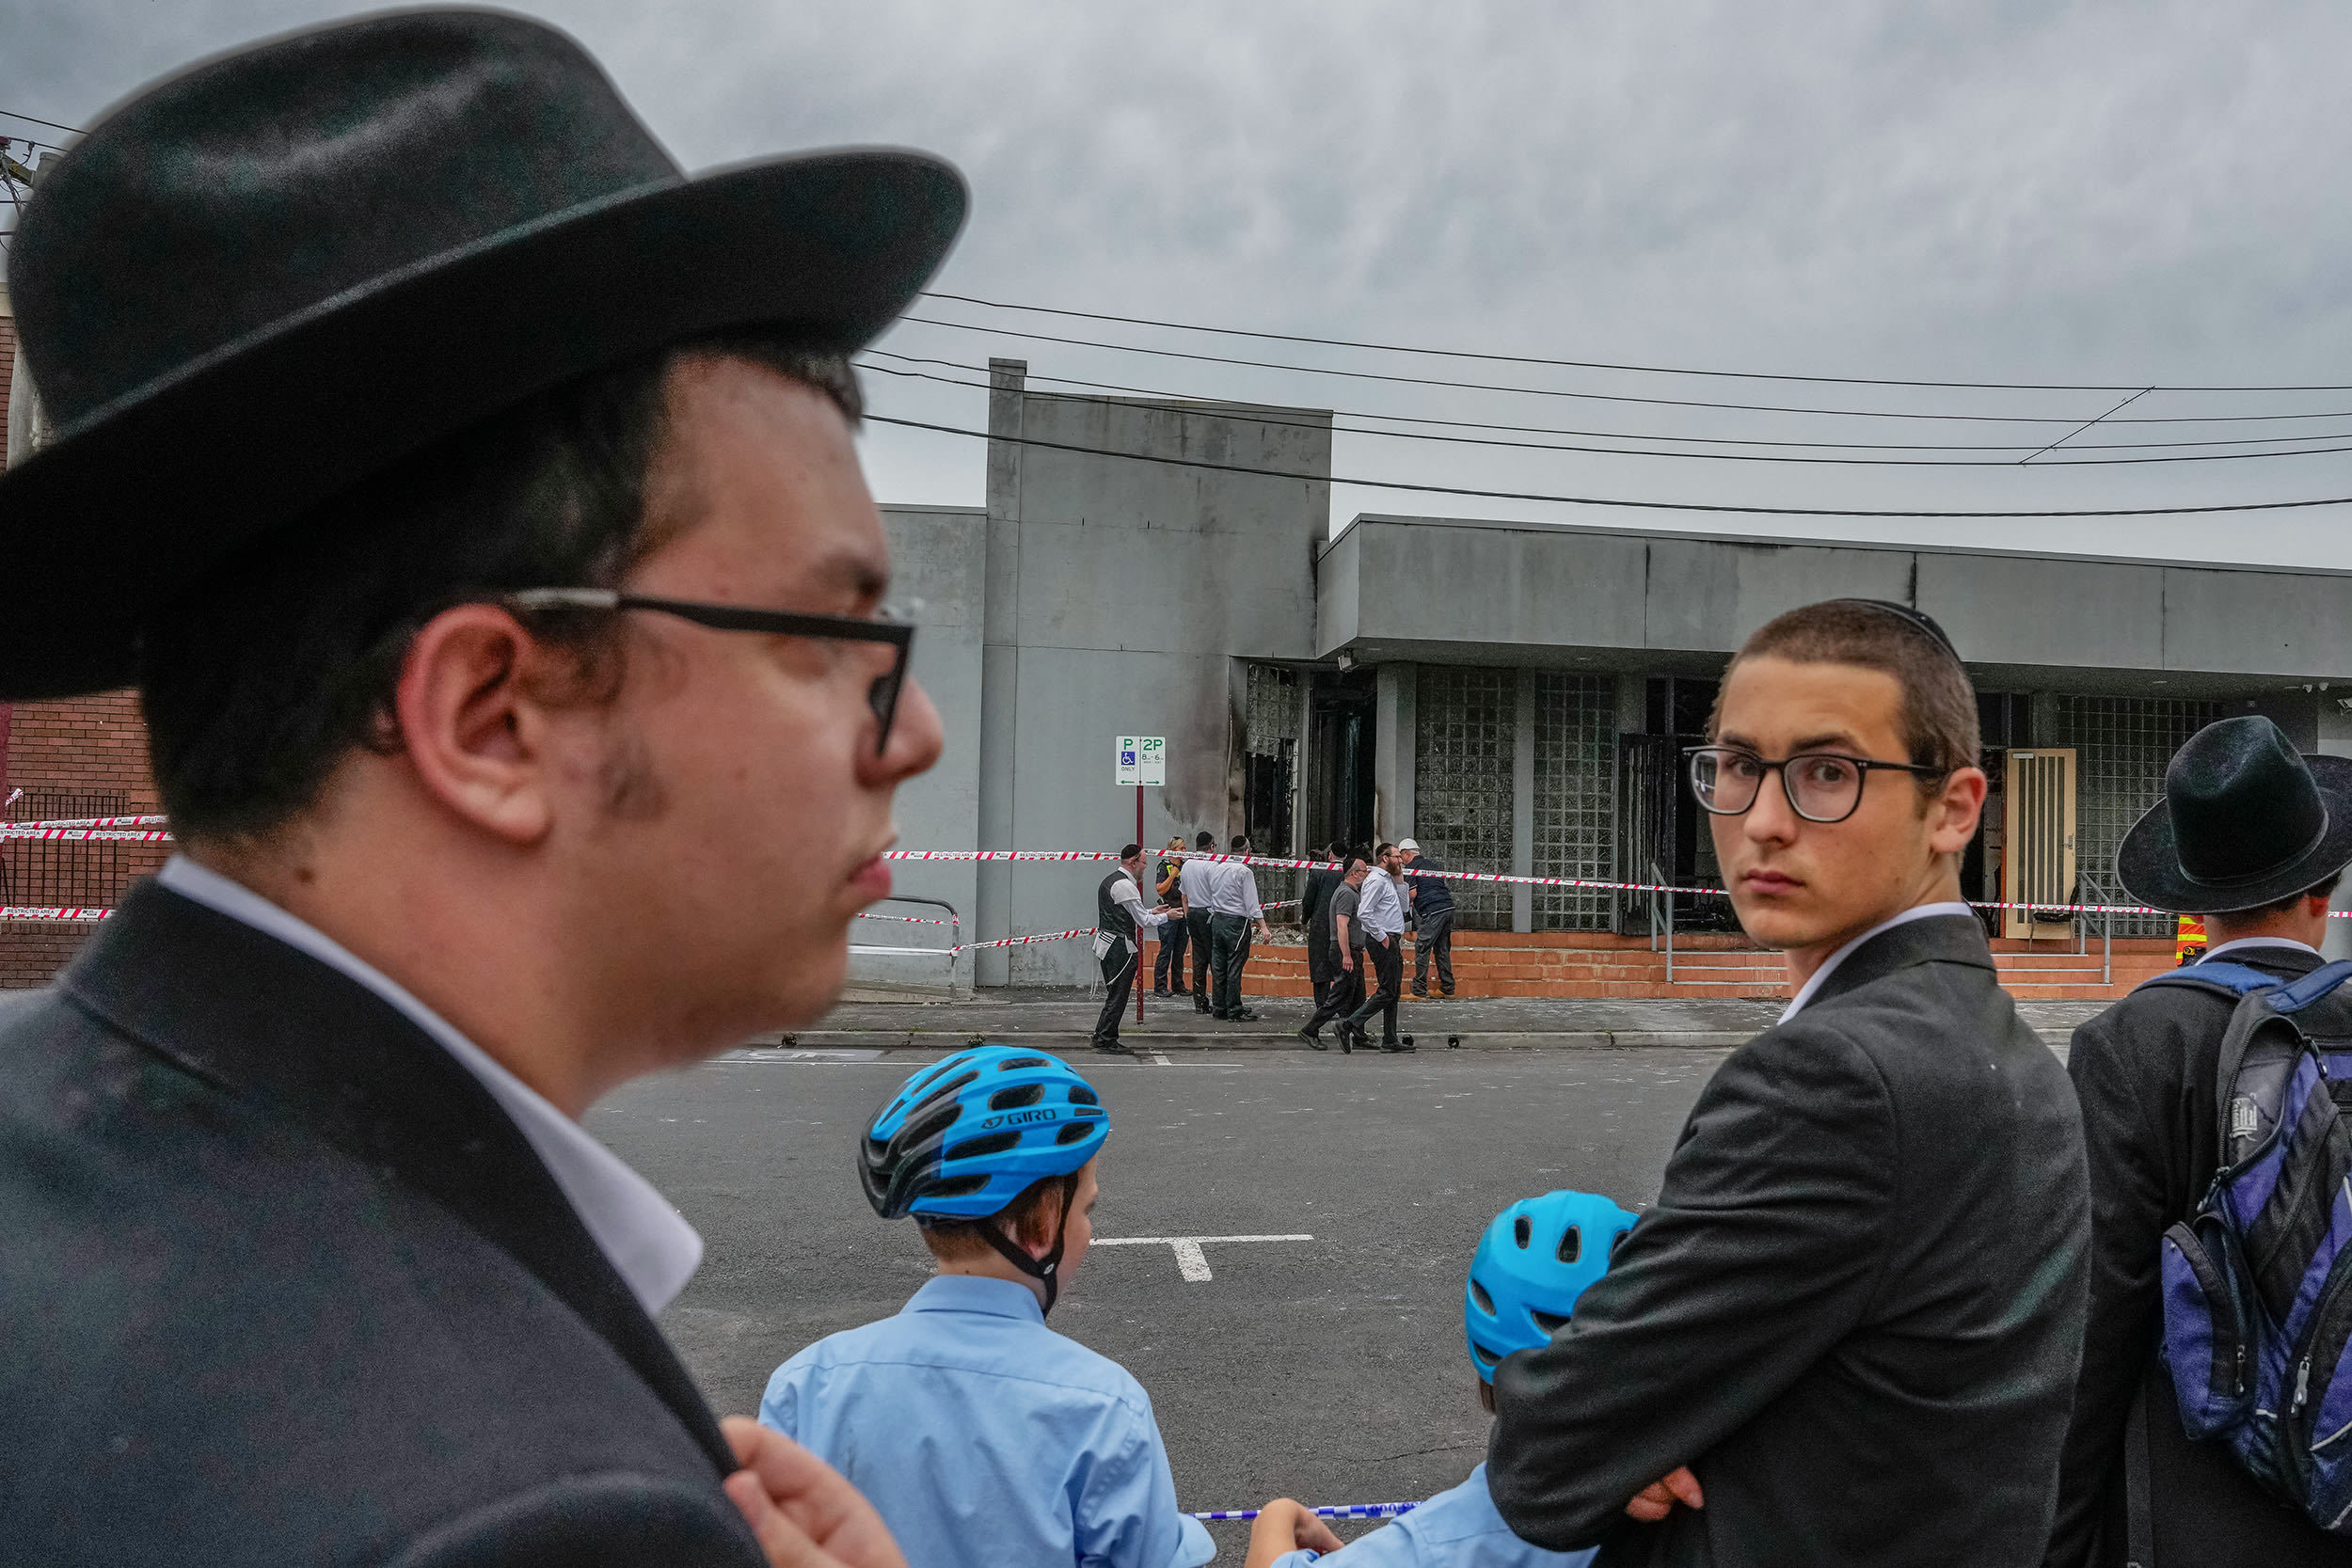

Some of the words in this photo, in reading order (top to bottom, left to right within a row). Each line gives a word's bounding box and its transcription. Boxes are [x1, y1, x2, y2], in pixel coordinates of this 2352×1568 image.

[1124, 738, 1134, 750] P
[1143, 738, 1163, 751] 2P
[1008, 1108, 1056, 1125] GIRO
